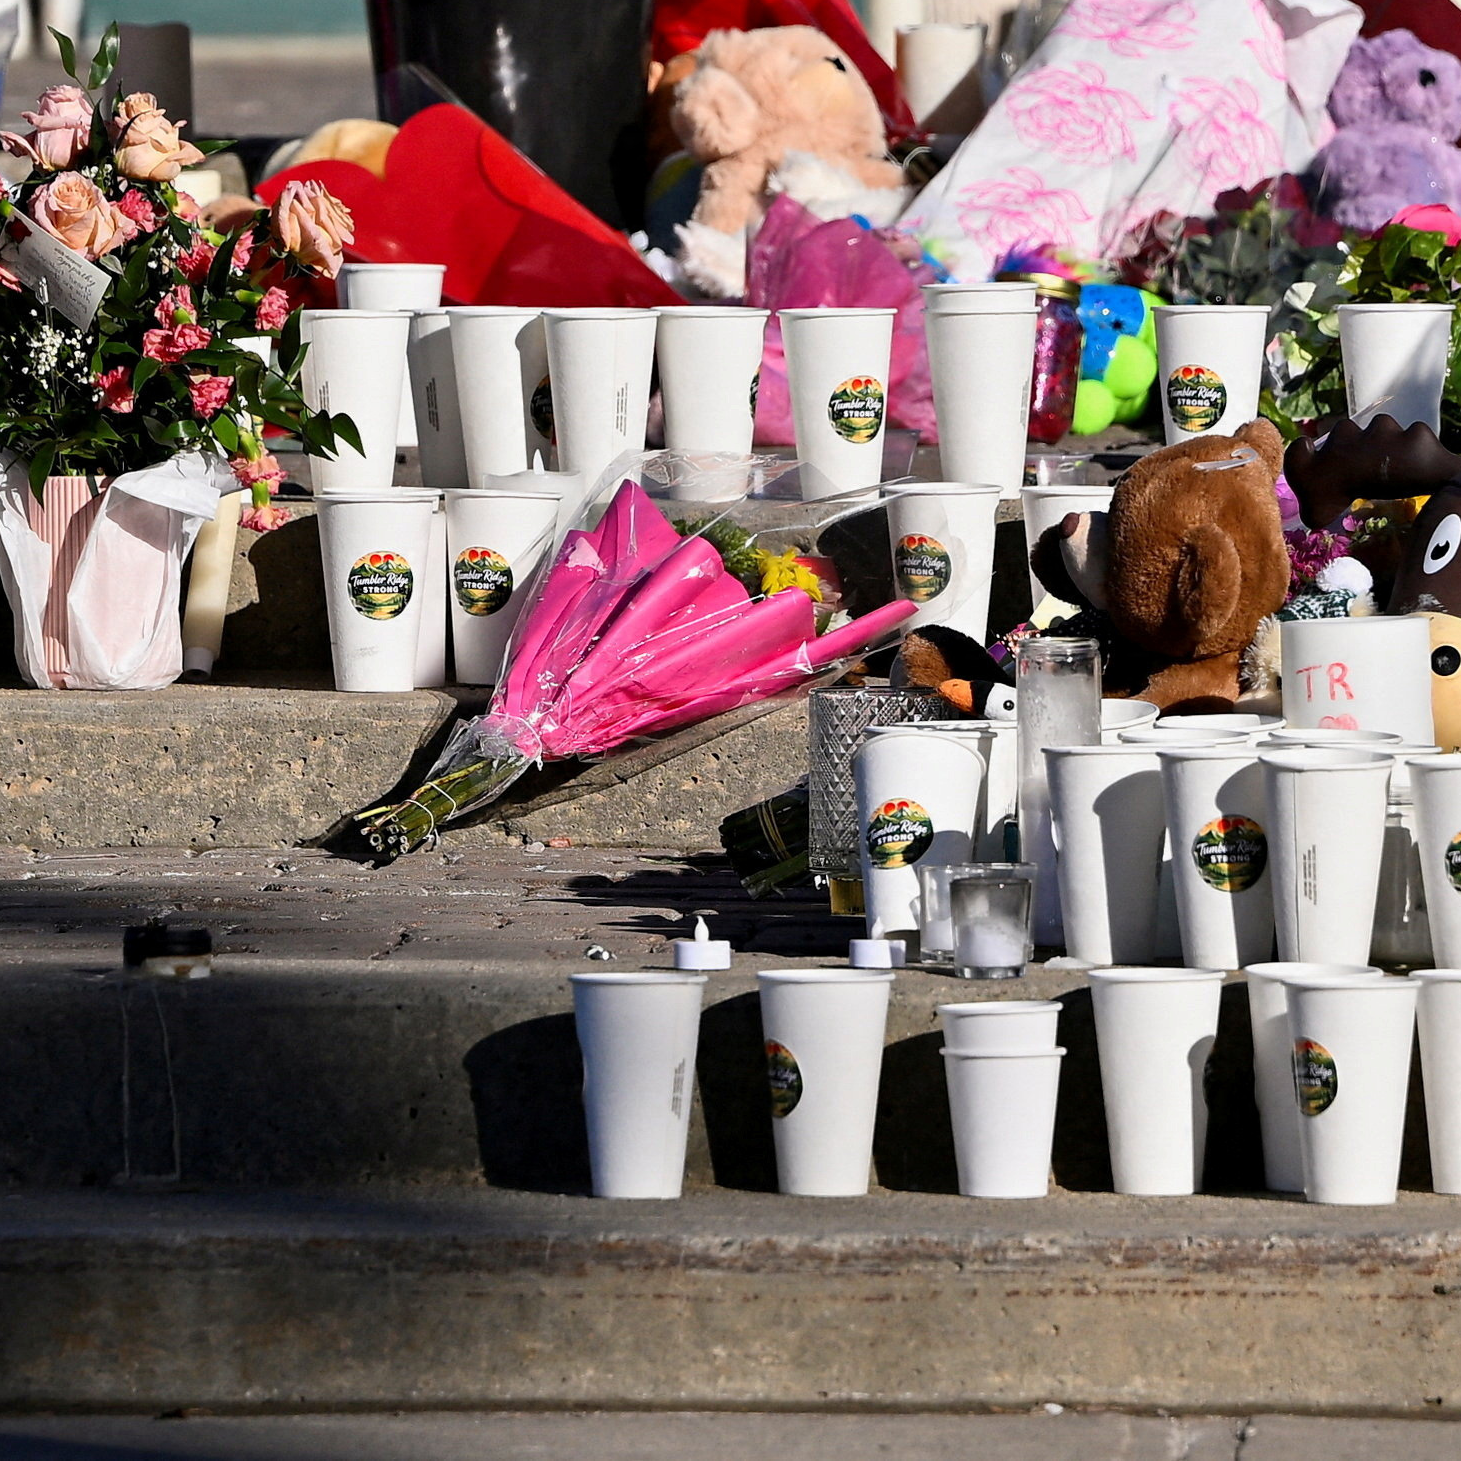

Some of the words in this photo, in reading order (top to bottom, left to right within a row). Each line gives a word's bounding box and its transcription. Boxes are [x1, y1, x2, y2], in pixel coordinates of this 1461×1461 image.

[1169, 387, 1198, 397] Tumbler
[1196, 385, 1222, 401] Ridge
[831, 397, 866, 409] Tumbler
[865, 396, 882, 411] Ridg
[843, 410, 875, 418] STRONG
[920, 555, 946, 571] Ridge
[456, 570, 484, 581] Tumbler
[481, 569, 508, 584] Ridge
[903, 567, 934, 576] STRONG
[351, 574, 387, 586] Tumbler
[384, 573, 409, 588] Ridge
[463, 581, 495, 589] STRONG
[363, 586, 398, 594] STRONG
[870, 824, 902, 839] Tumbler
[900, 819, 928, 836] Ridge
[877, 833, 915, 845] STRONG
[1197, 842, 1236, 855] Tumbler
[1237, 840, 1262, 855] Ridge
[1210, 854, 1250, 863] STRONG
[1308, 1062, 1333, 1080] Ridge
